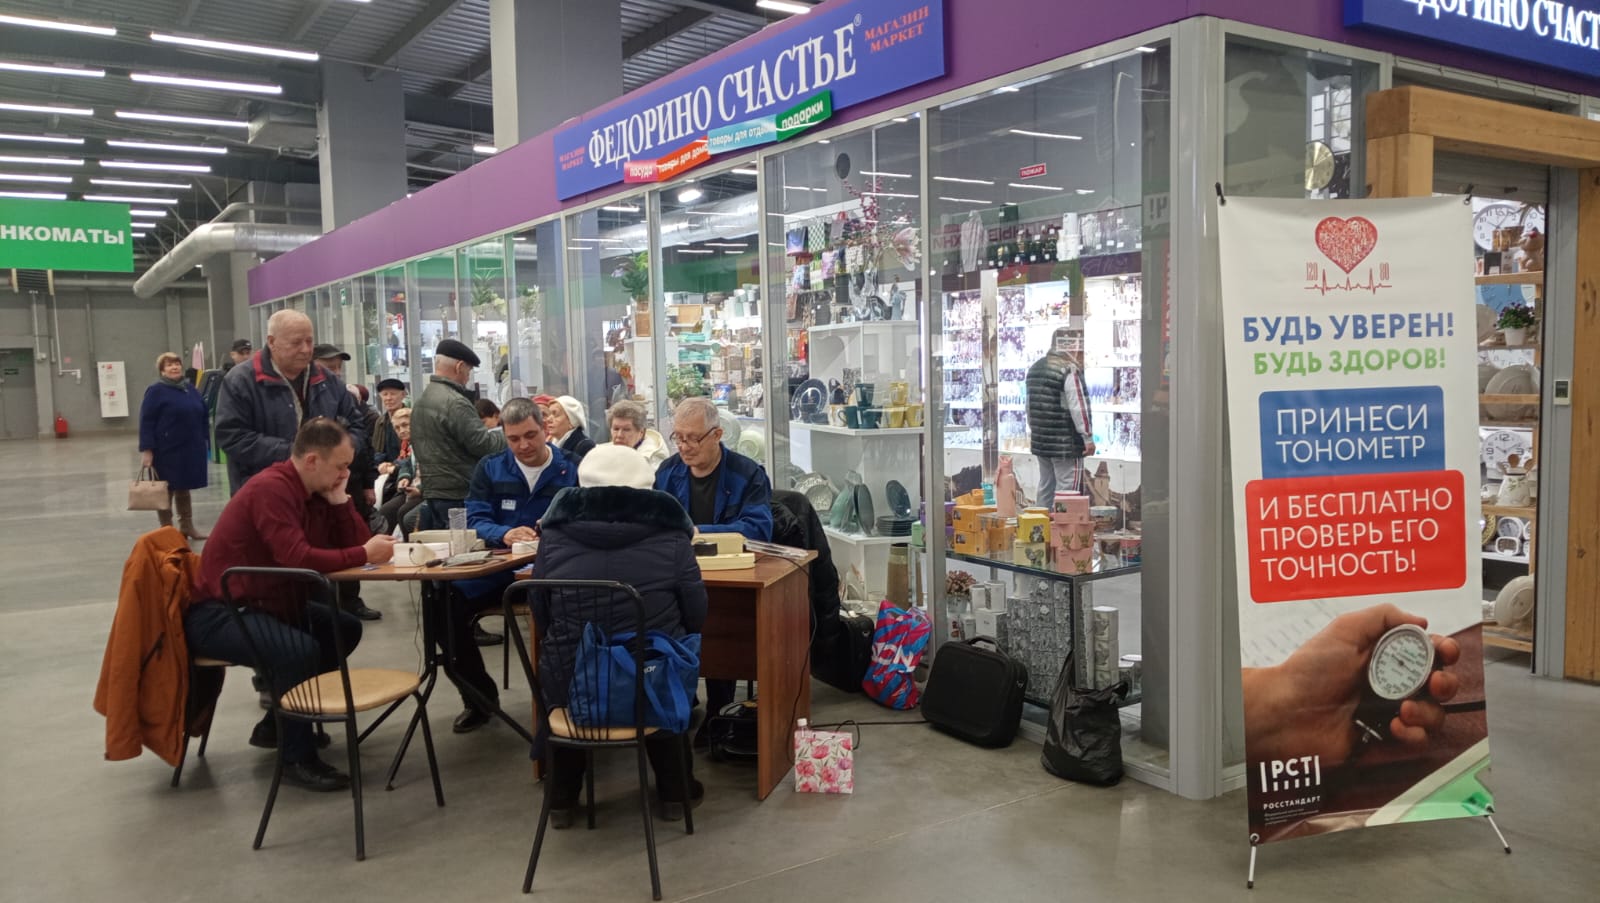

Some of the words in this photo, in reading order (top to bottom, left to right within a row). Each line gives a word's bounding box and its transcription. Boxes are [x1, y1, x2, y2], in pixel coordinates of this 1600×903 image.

[865, 5, 929, 40] МАГАЗИН
[870, 22, 924, 54] МАРКЕТ
[588, 85, 712, 170] ФЕДОРИНО
[781, 100, 824, 129] подарки
[734, 127, 747, 142] для
[629, 165, 654, 180] посуда
[1243, 315, 1323, 346] БУДЬ
[1328, 312, 1454, 341] УВЕРЕН!
[1253, 351, 1323, 377] БУДЬ
[1328, 347, 1447, 376] ЗДОРОВ!
[1276, 403, 1428, 436] ПРИНЕСИ
[1275, 435, 1426, 464] ТОНОМЕТР
[1259, 496, 1279, 521] И
[1288, 487, 1453, 519] БЕСПЛАТНО
[1260, 521, 1384, 552] ПРОВЕРЬ
[1391, 517, 1439, 543] ЕГО
[1260, 549, 1417, 582] ТОЧНОСТЬ!
[1271, 756, 1313, 779] РСТ
[1263, 796, 1321, 810] РОССТАНДАРТ
